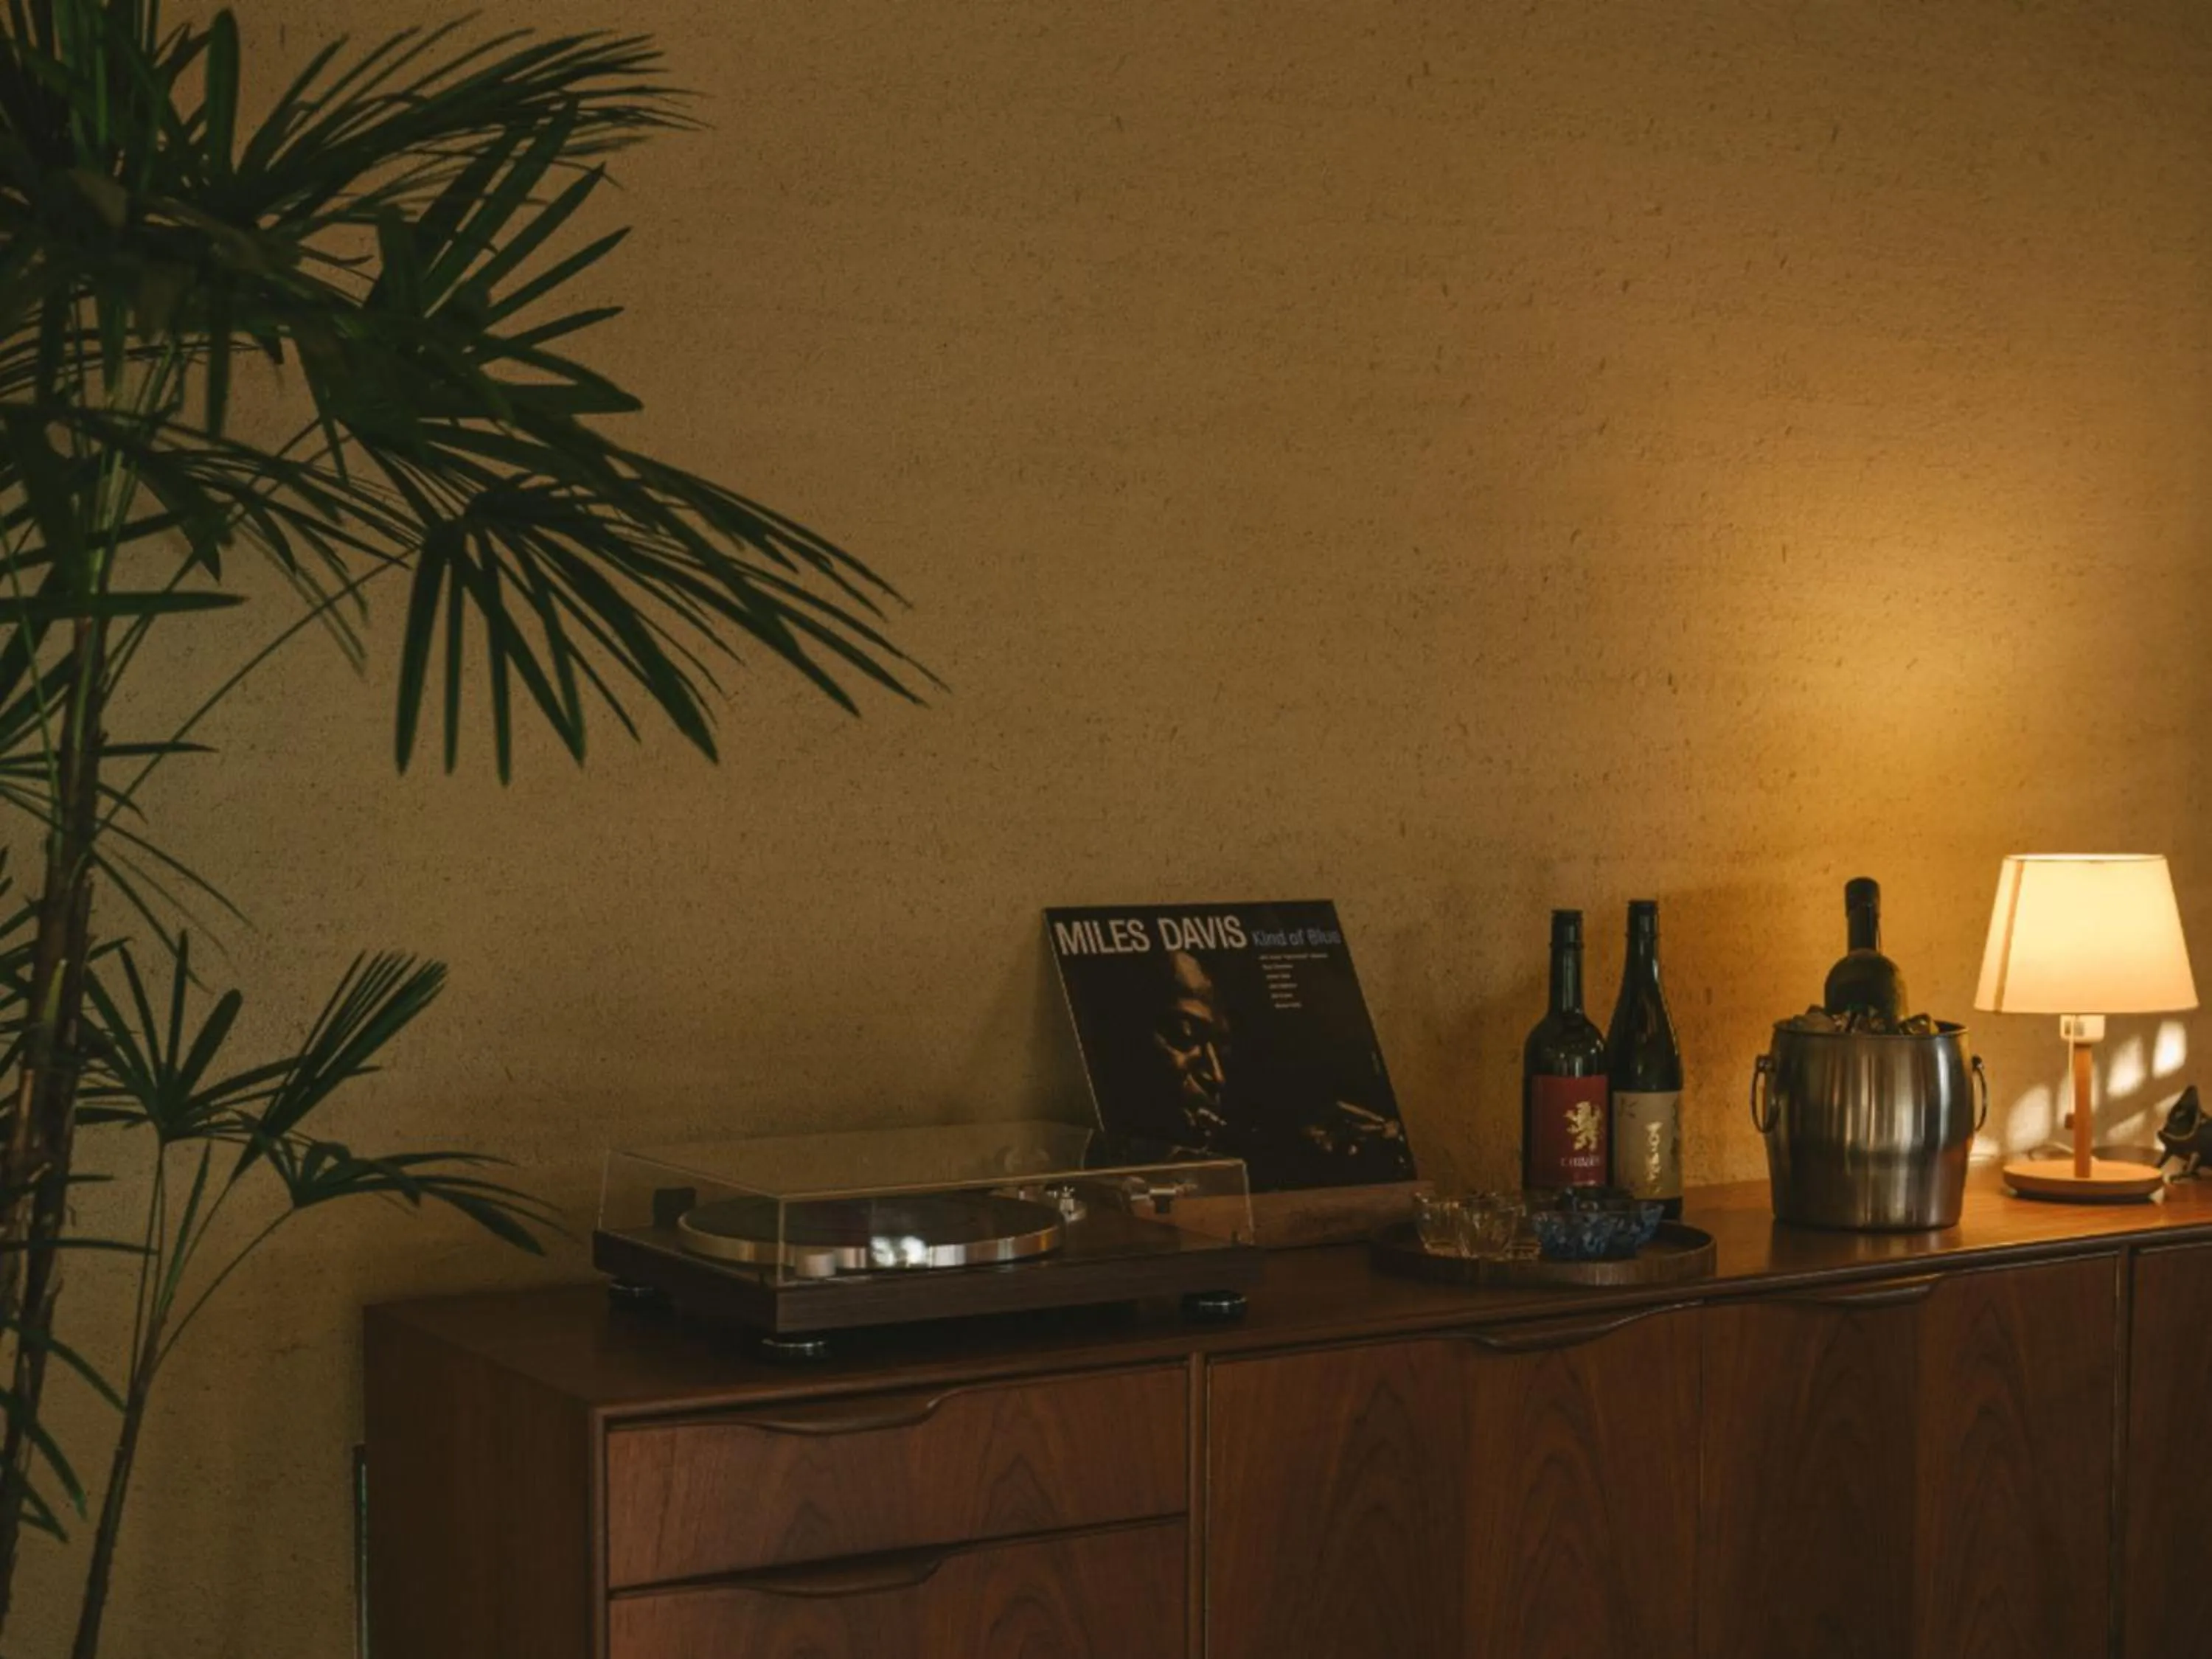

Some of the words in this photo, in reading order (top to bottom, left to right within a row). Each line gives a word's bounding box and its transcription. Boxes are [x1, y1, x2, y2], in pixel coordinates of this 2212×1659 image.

[1054, 919, 1150, 955] MILES
[1157, 915, 1247, 950] DAVIS
[1252, 929, 1287, 946] Kind
[1289, 928, 1304, 945] of
[1307, 928, 1341, 946] Blue
